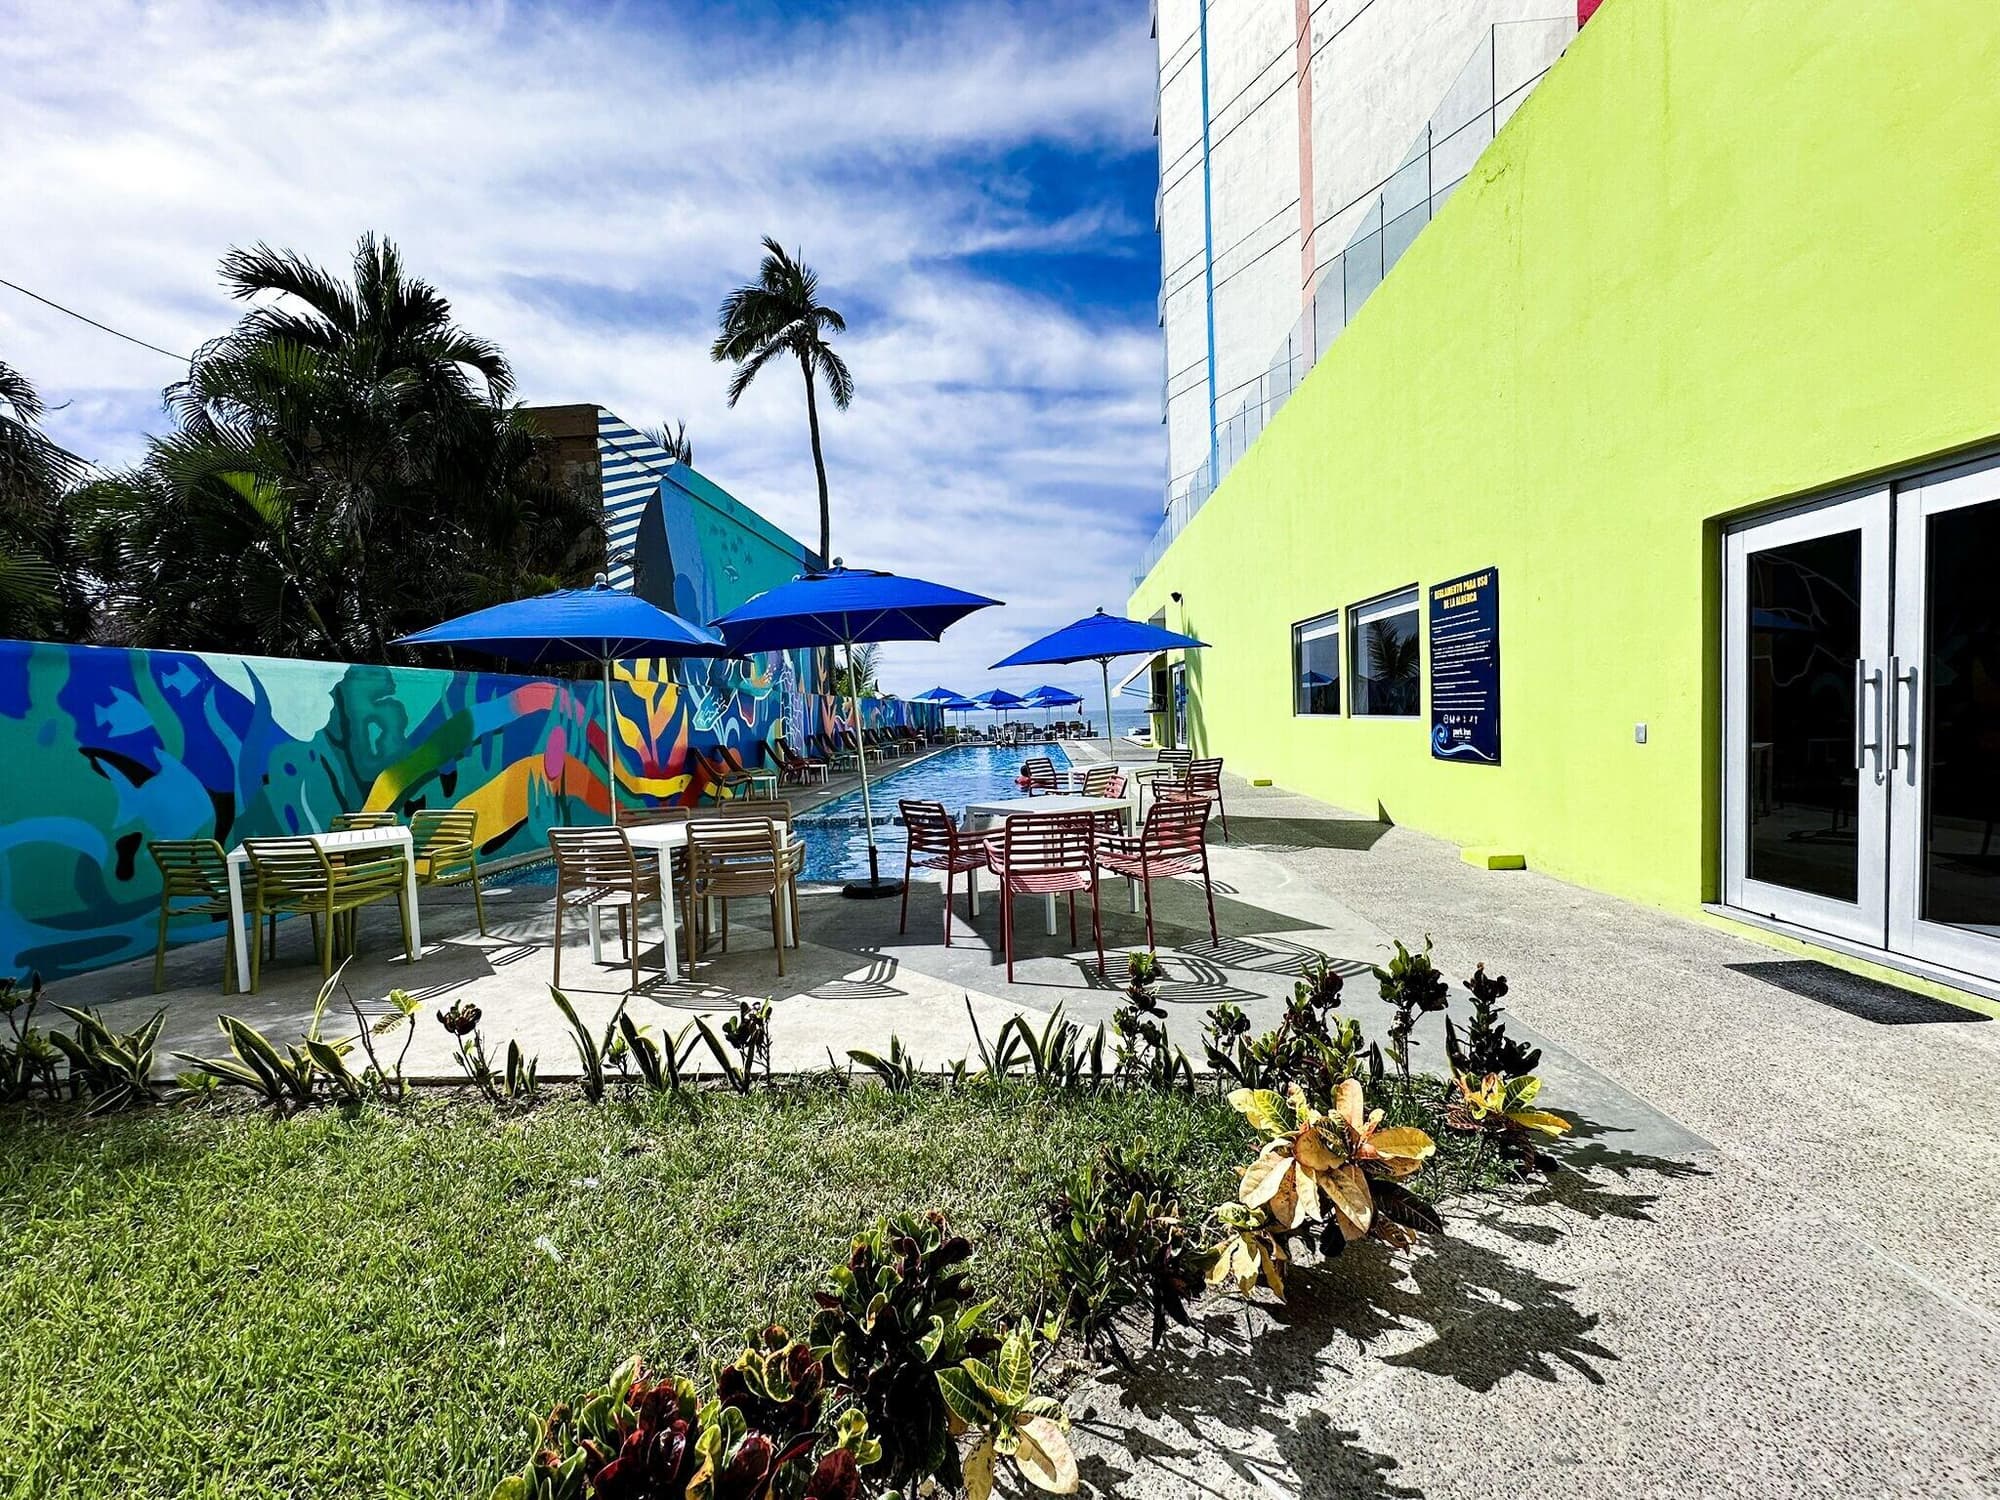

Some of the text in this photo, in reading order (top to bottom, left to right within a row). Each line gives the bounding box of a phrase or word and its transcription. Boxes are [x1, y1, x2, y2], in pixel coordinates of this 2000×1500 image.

[1463, 578, 1477, 591] PARA
[1477, 574, 1488, 588] USO
[1455, 591, 1477, 606] ALBERCA
